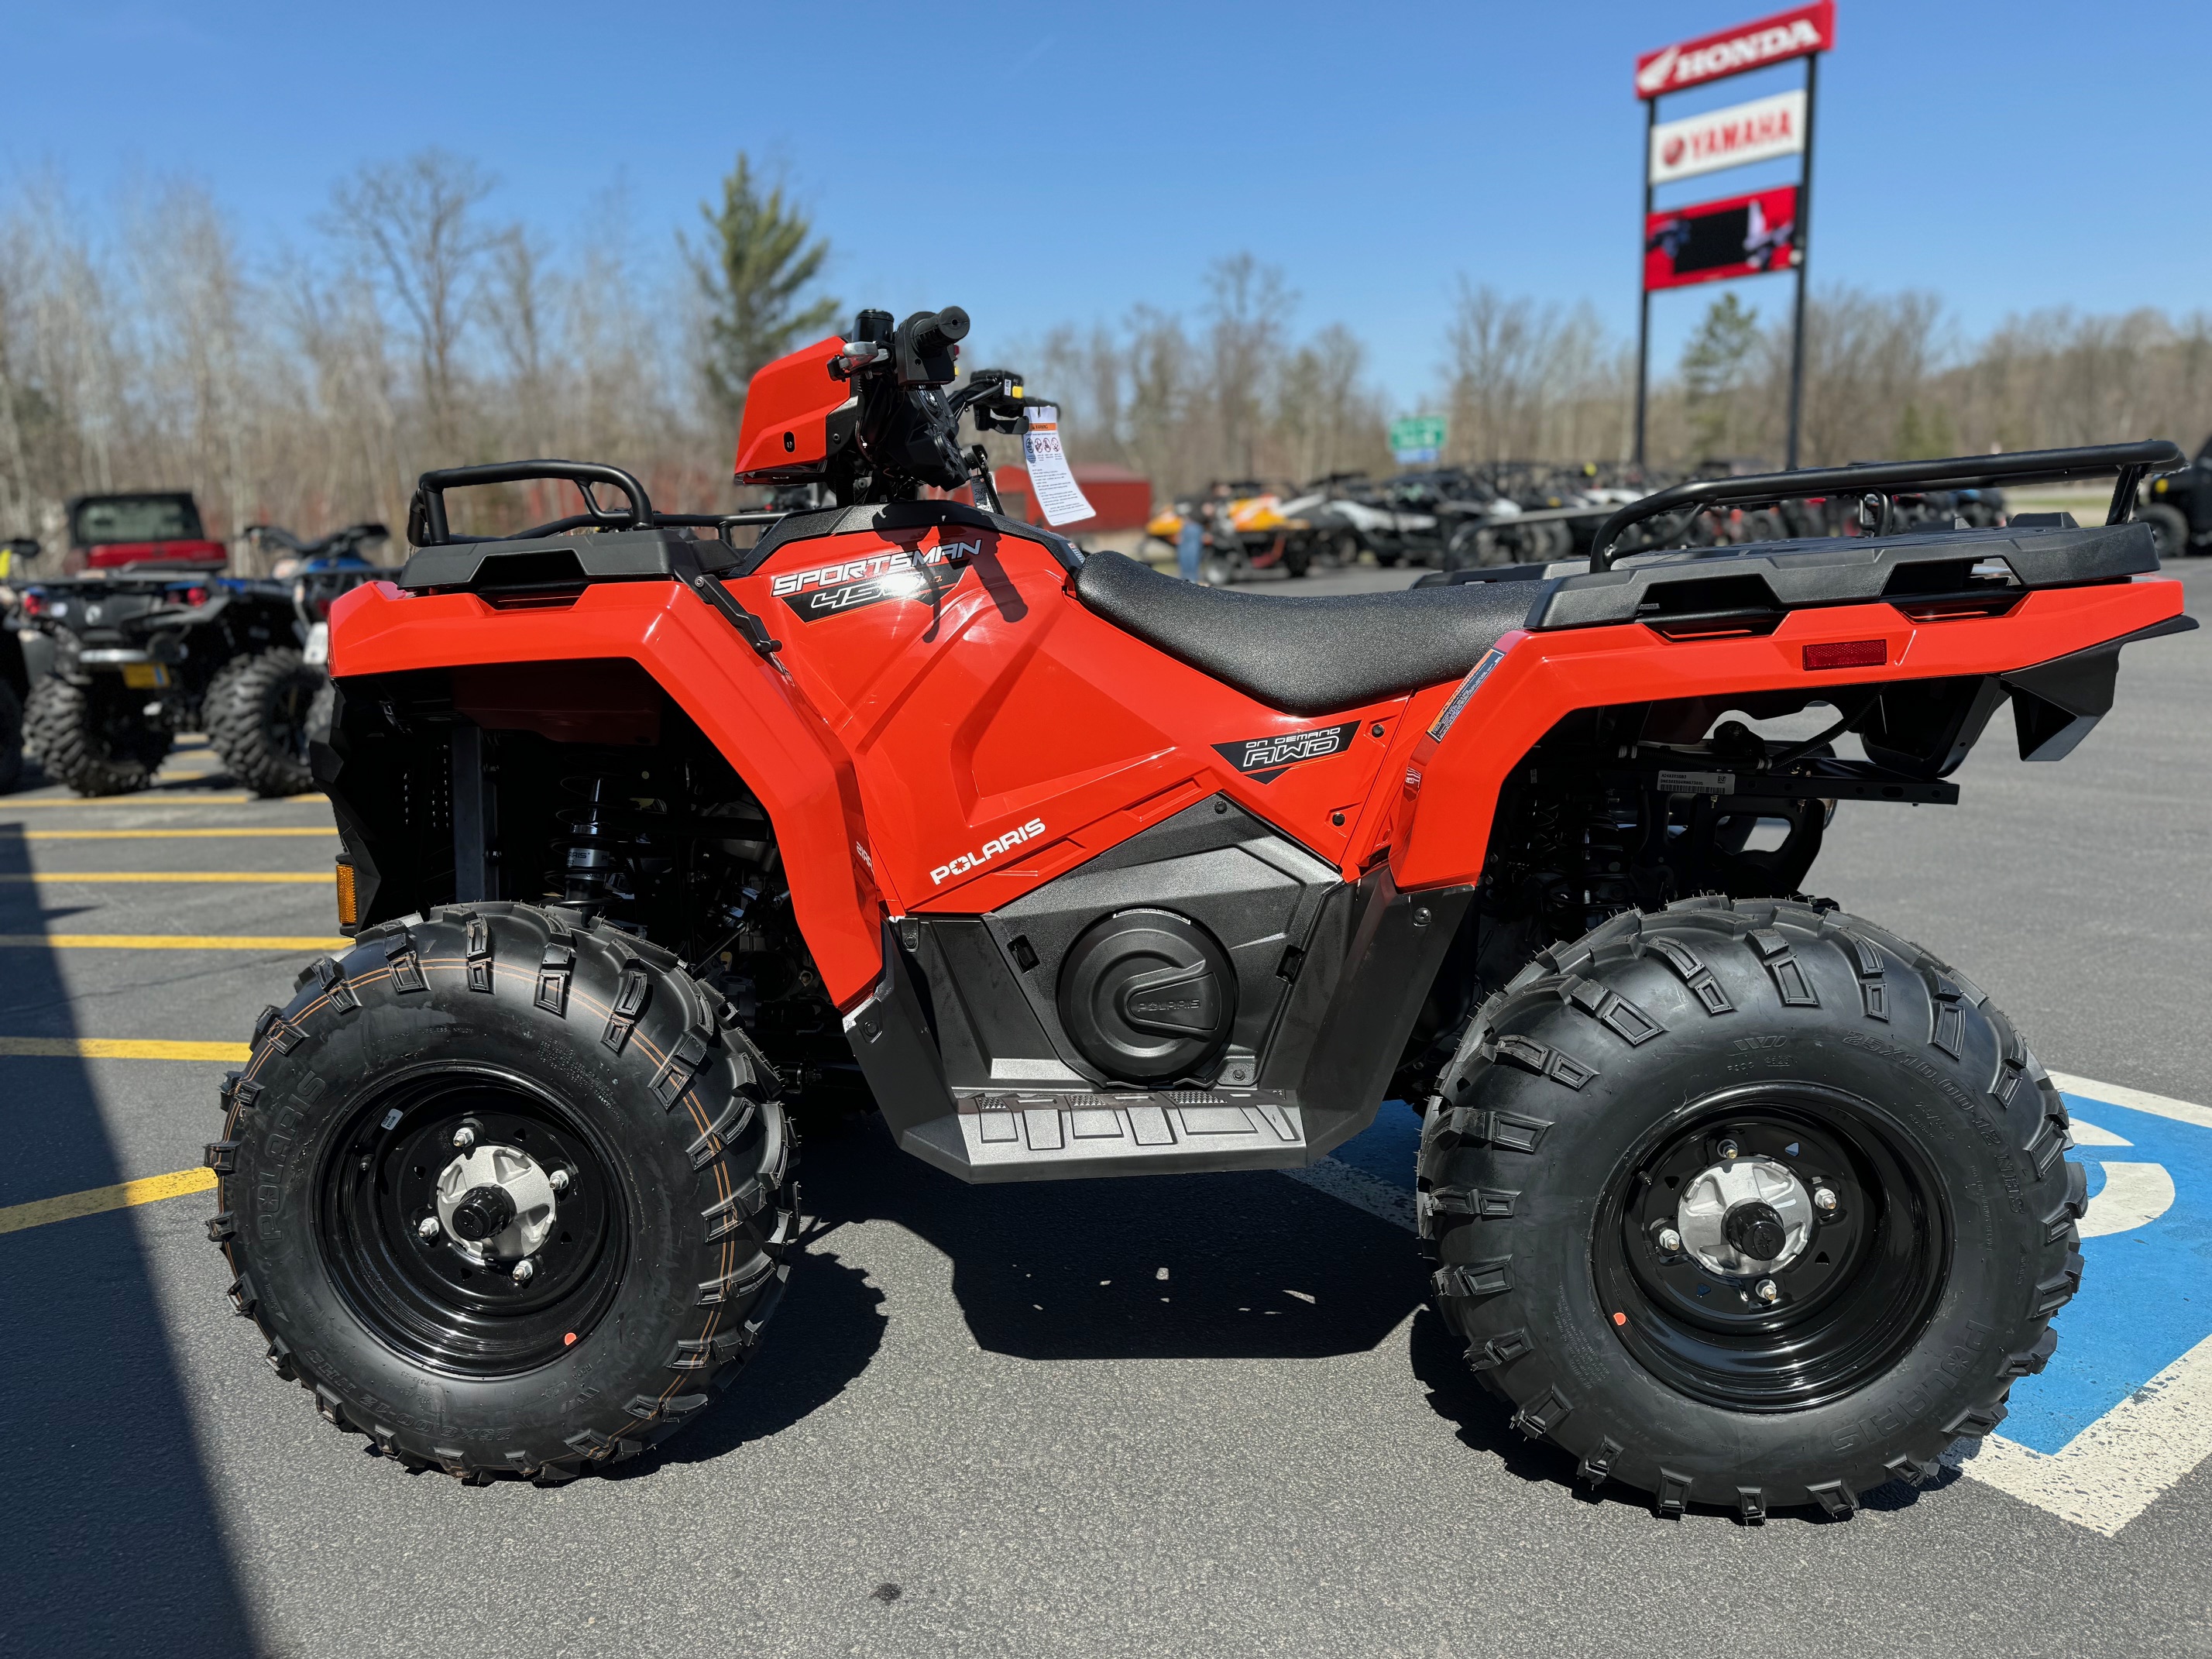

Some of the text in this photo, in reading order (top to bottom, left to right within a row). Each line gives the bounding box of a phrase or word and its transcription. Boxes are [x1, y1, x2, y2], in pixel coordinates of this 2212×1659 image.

[1676, 19, 1821, 83] HONDA
[1692, 109, 1792, 160] YAMAHA
[771, 539, 982, 597] SPORTSMAN
[810, 572, 923, 609] 45
[1242, 736, 1340, 768] AWD
[1245, 726, 1341, 748] ON DEMAND
[929, 817, 1046, 885] POLARIS
[1136, 998, 1201, 1013] POLARIS
[1843, 1029, 2027, 1216] 25X10.00-12 NHS
[256, 1070, 328, 1242] POLARIS
[305, 1348, 358, 1394] NHS
[1829, 1320, 1994, 1455] POLARIS
